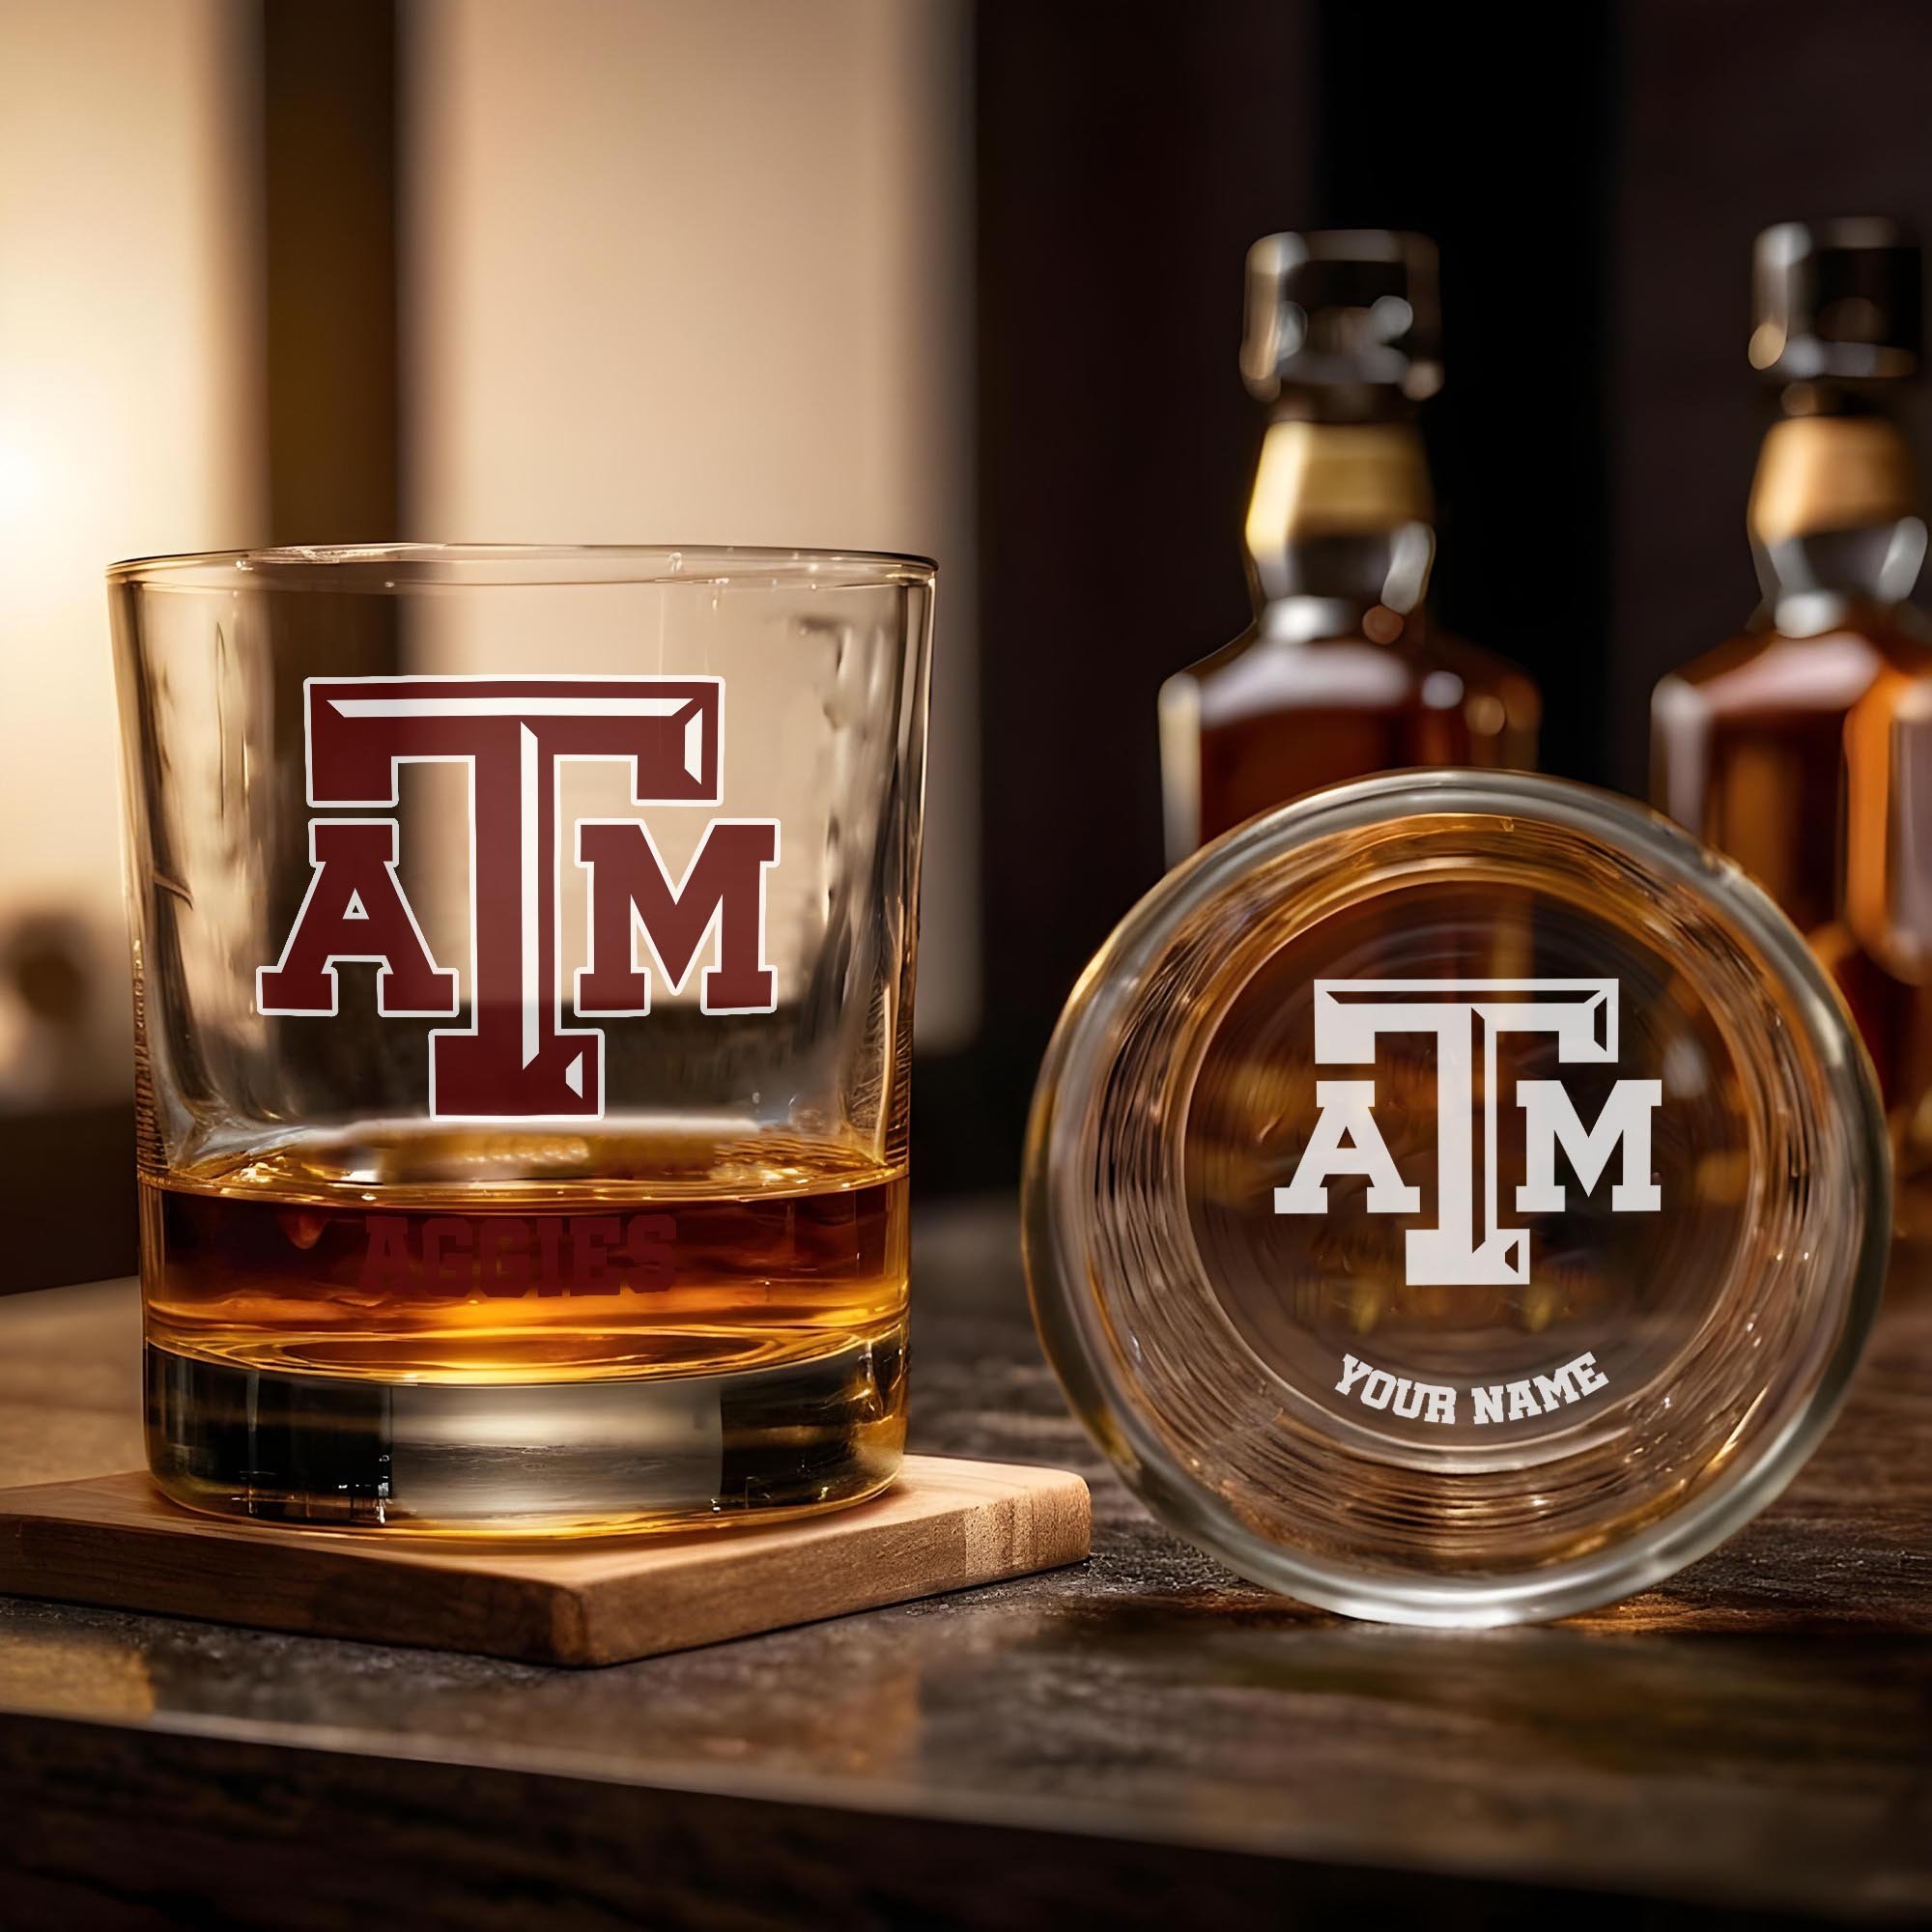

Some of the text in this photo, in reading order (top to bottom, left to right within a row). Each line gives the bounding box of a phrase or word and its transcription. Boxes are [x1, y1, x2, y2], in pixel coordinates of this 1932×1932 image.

[358, 1213, 677, 1298] AGGIES
[1334, 1351, 1610, 1425] YOUR NAME
